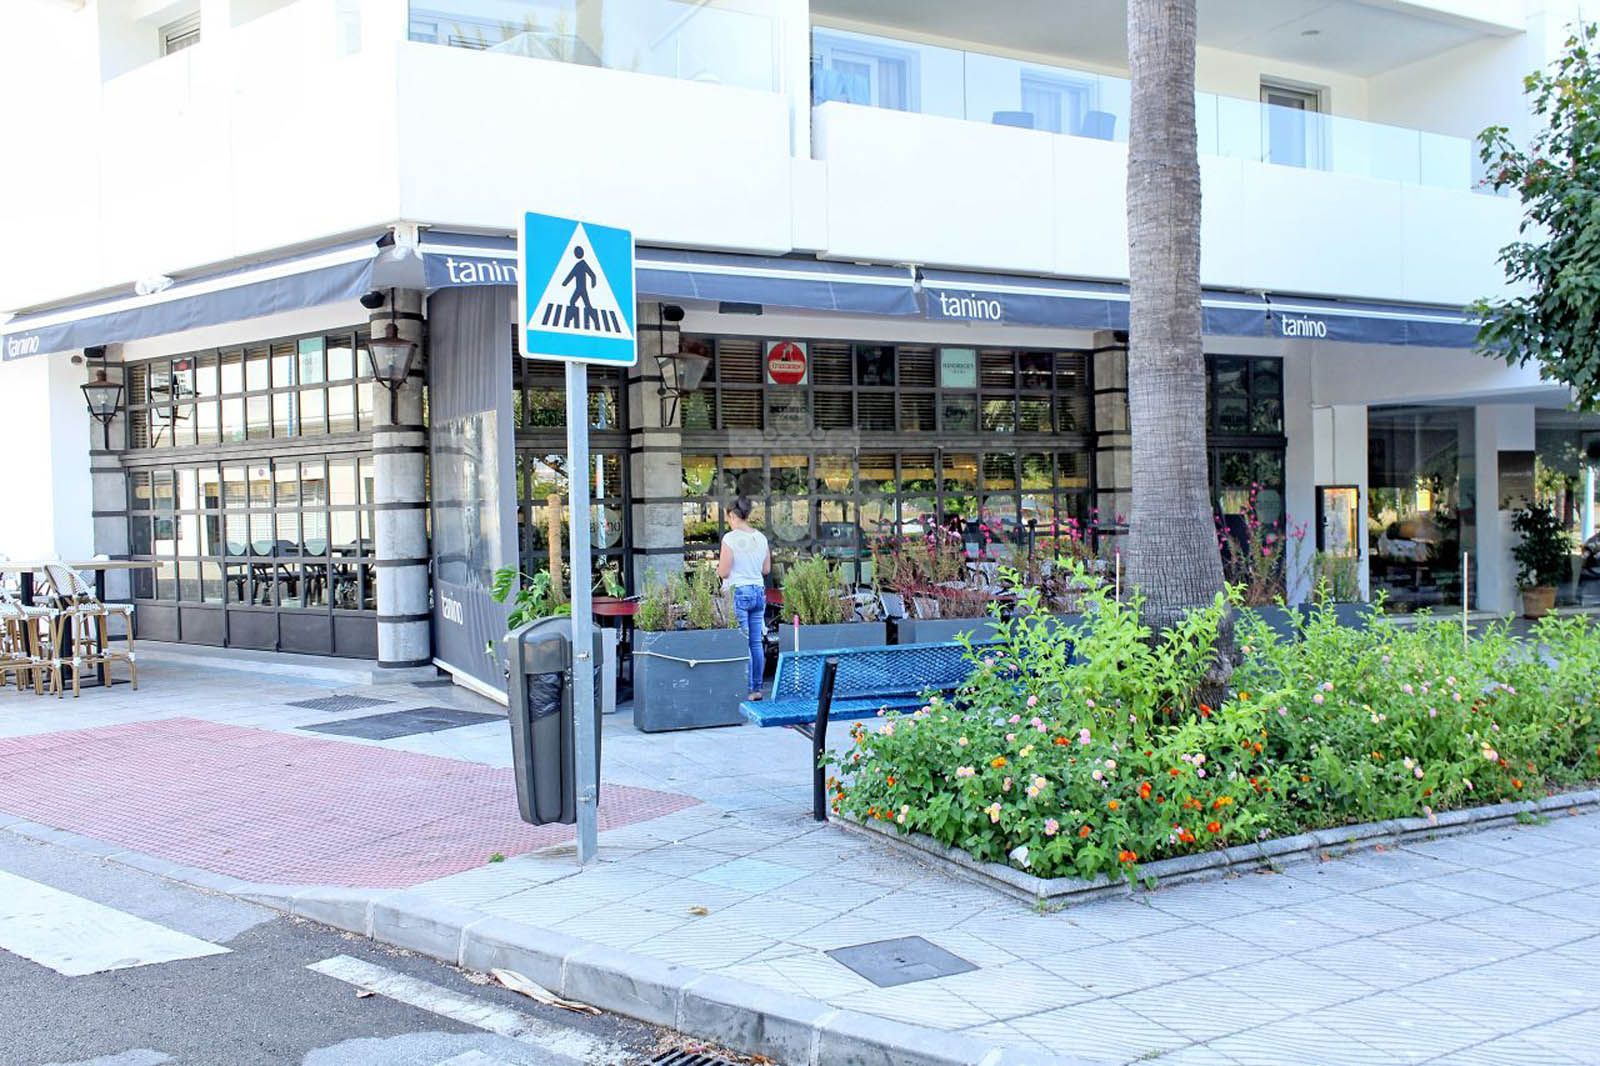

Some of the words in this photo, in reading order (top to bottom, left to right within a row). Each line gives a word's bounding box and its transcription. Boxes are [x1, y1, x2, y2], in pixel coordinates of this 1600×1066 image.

[446, 257, 518, 283] tanin
[940, 292, 1001, 320] tanino
[1281, 314, 1327, 338] tanino
[8, 336, 40, 358] tanino
[441, 590, 464, 625] tanino
